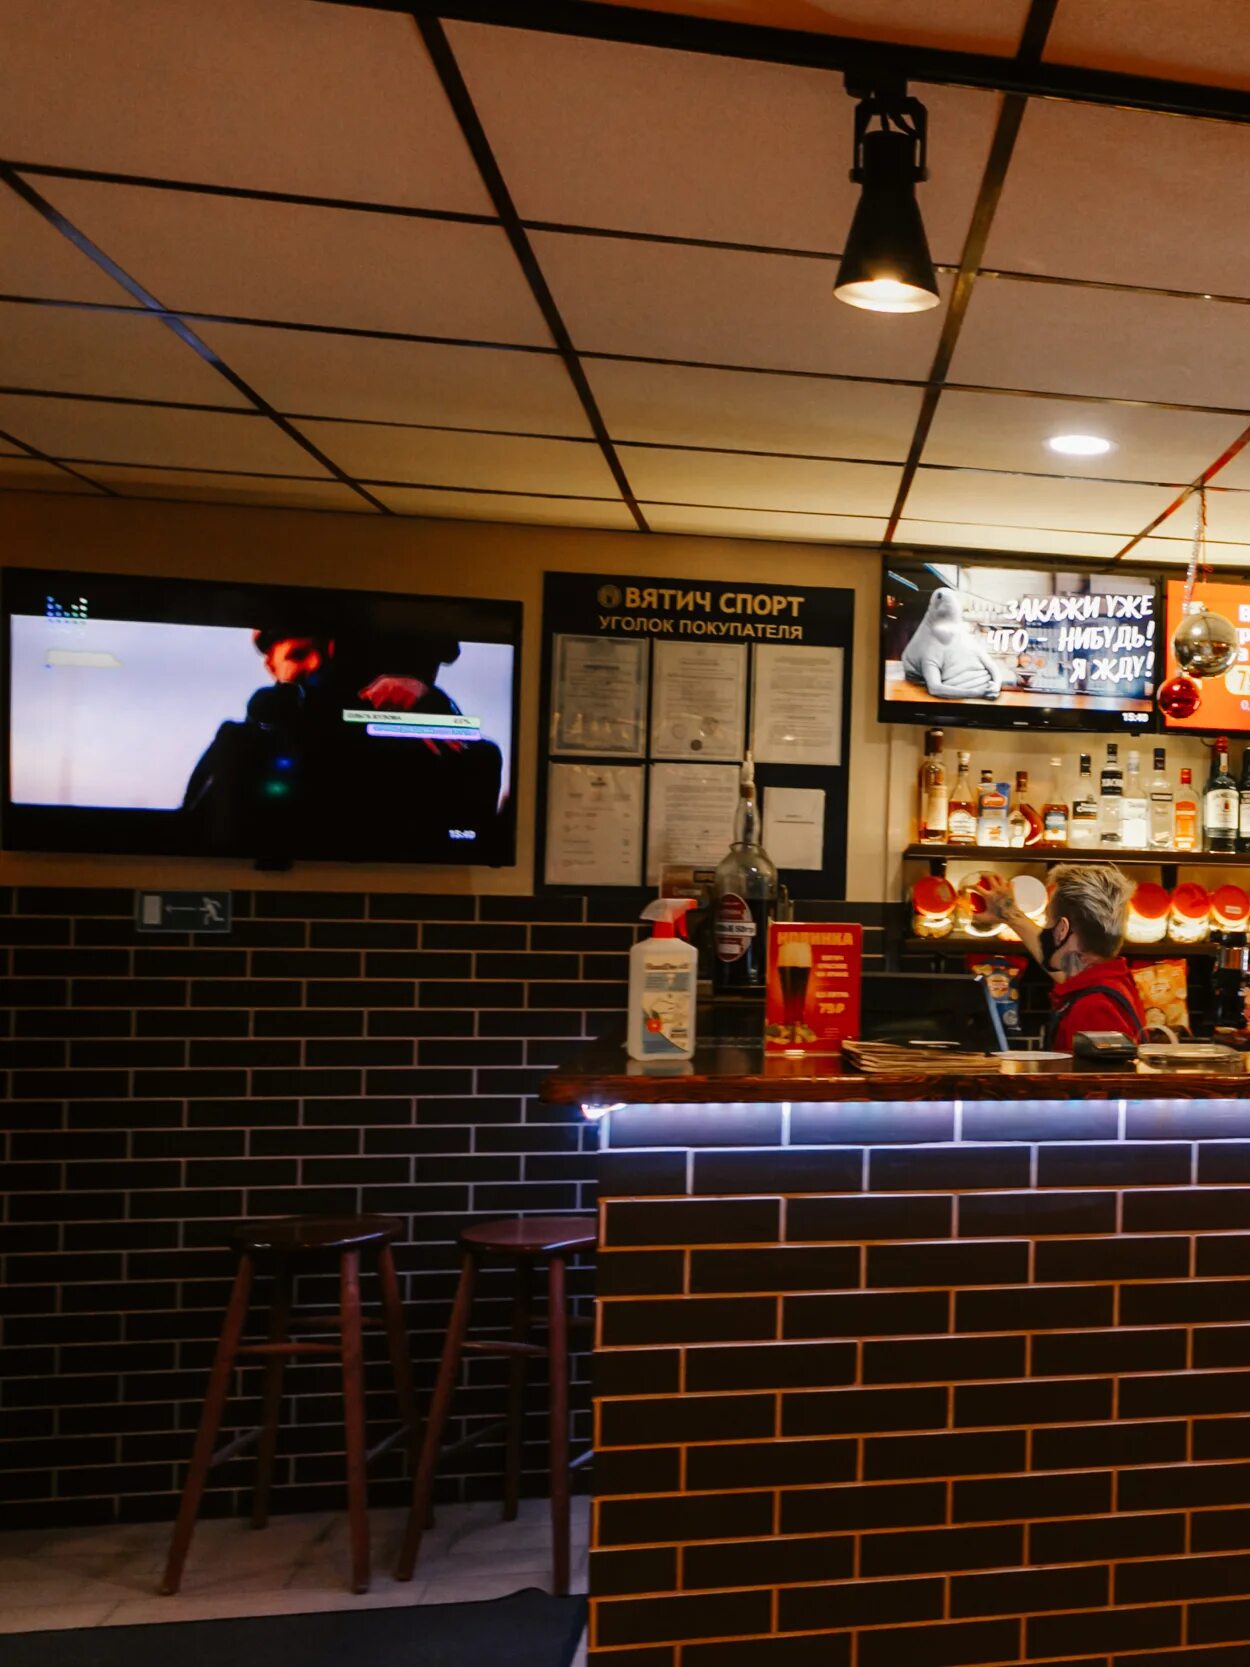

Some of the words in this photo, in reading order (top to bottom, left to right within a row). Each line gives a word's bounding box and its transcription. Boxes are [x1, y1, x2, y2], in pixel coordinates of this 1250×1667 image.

[624, 587, 711, 612] ВЯТИЧ
[719, 592, 805, 617] СПОРТ
[1003, 595, 1101, 622] ЗАКАЖИ
[1105, 594, 1155, 620] УЖЕ
[598, 615, 675, 633] УГОЛОК
[679, 619, 803, 640] ПОКУПАТЕЛЯ
[987, 629, 1029, 652] ЧТО
[1058, 620, 1156, 652] НИБУДЬ!
[1069, 658, 1088, 683] Я
[1091, 651, 1156, 683] ЖДУ!
